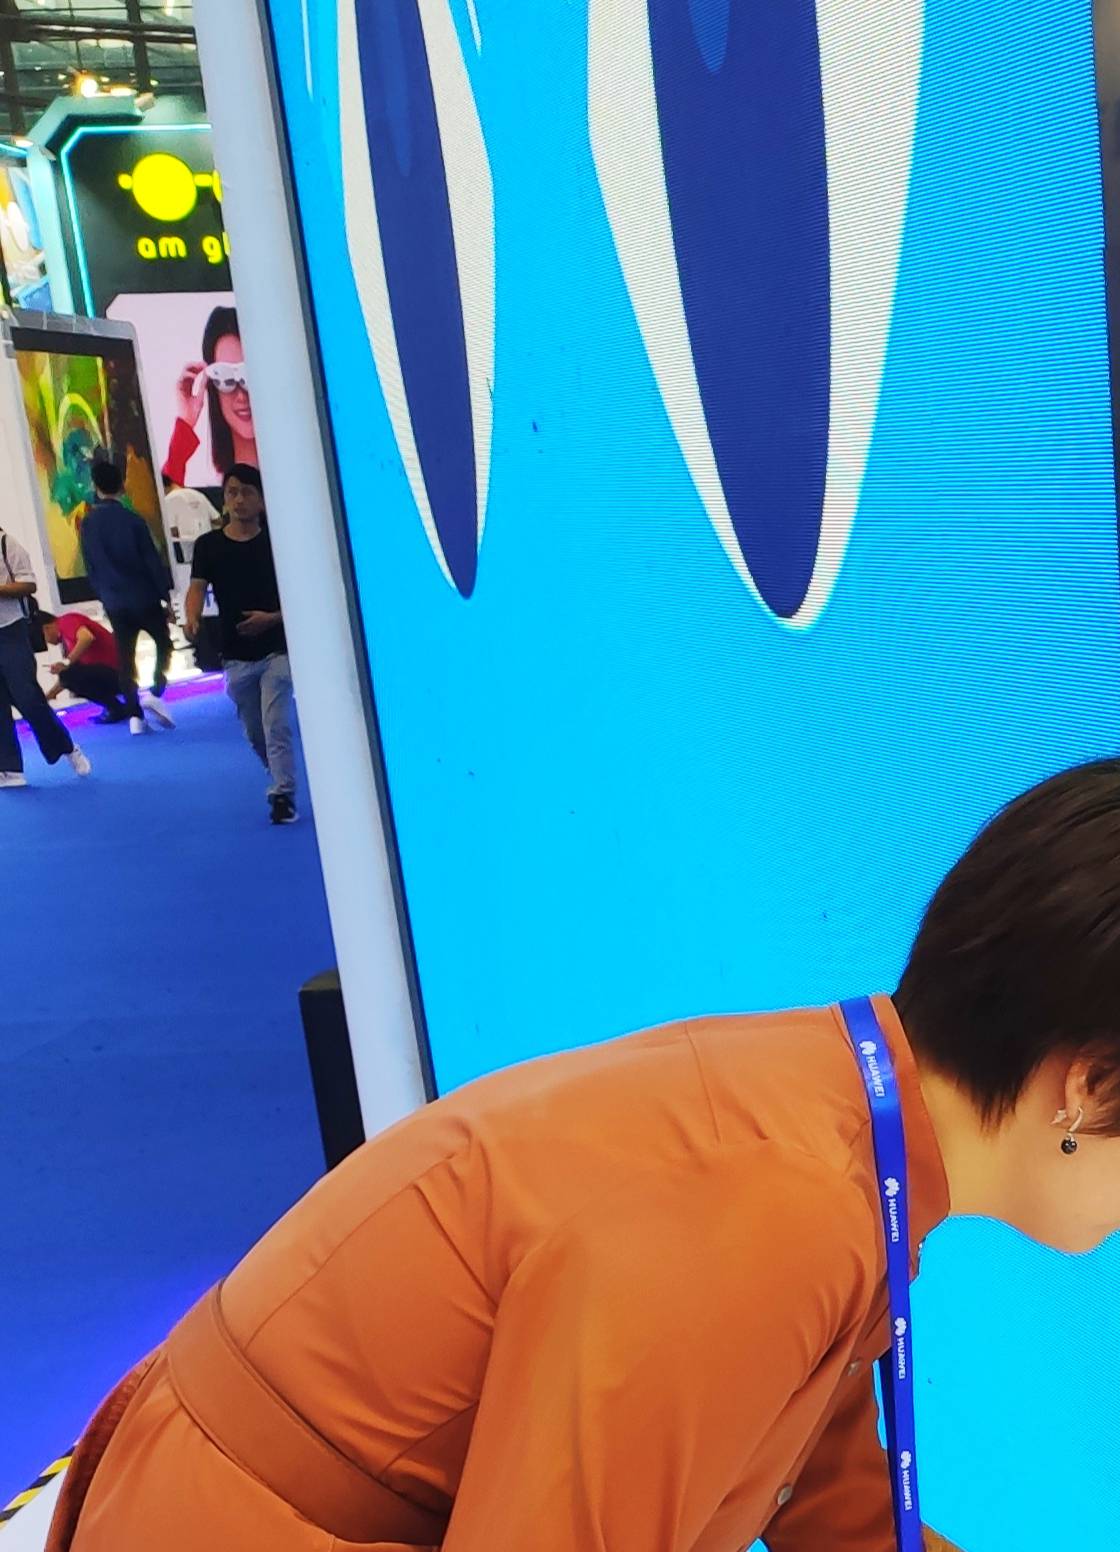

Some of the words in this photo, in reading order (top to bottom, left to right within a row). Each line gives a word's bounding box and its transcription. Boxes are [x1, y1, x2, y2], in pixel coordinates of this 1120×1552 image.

[138, 235, 187, 259] am
[866, 1055, 885, 1097] HUAWEI
[888, 1198, 900, 1243] HUAWEI
[897, 1337, 906, 1380] HUAWEI
[902, 1469, 913, 1511] HUAWEI
